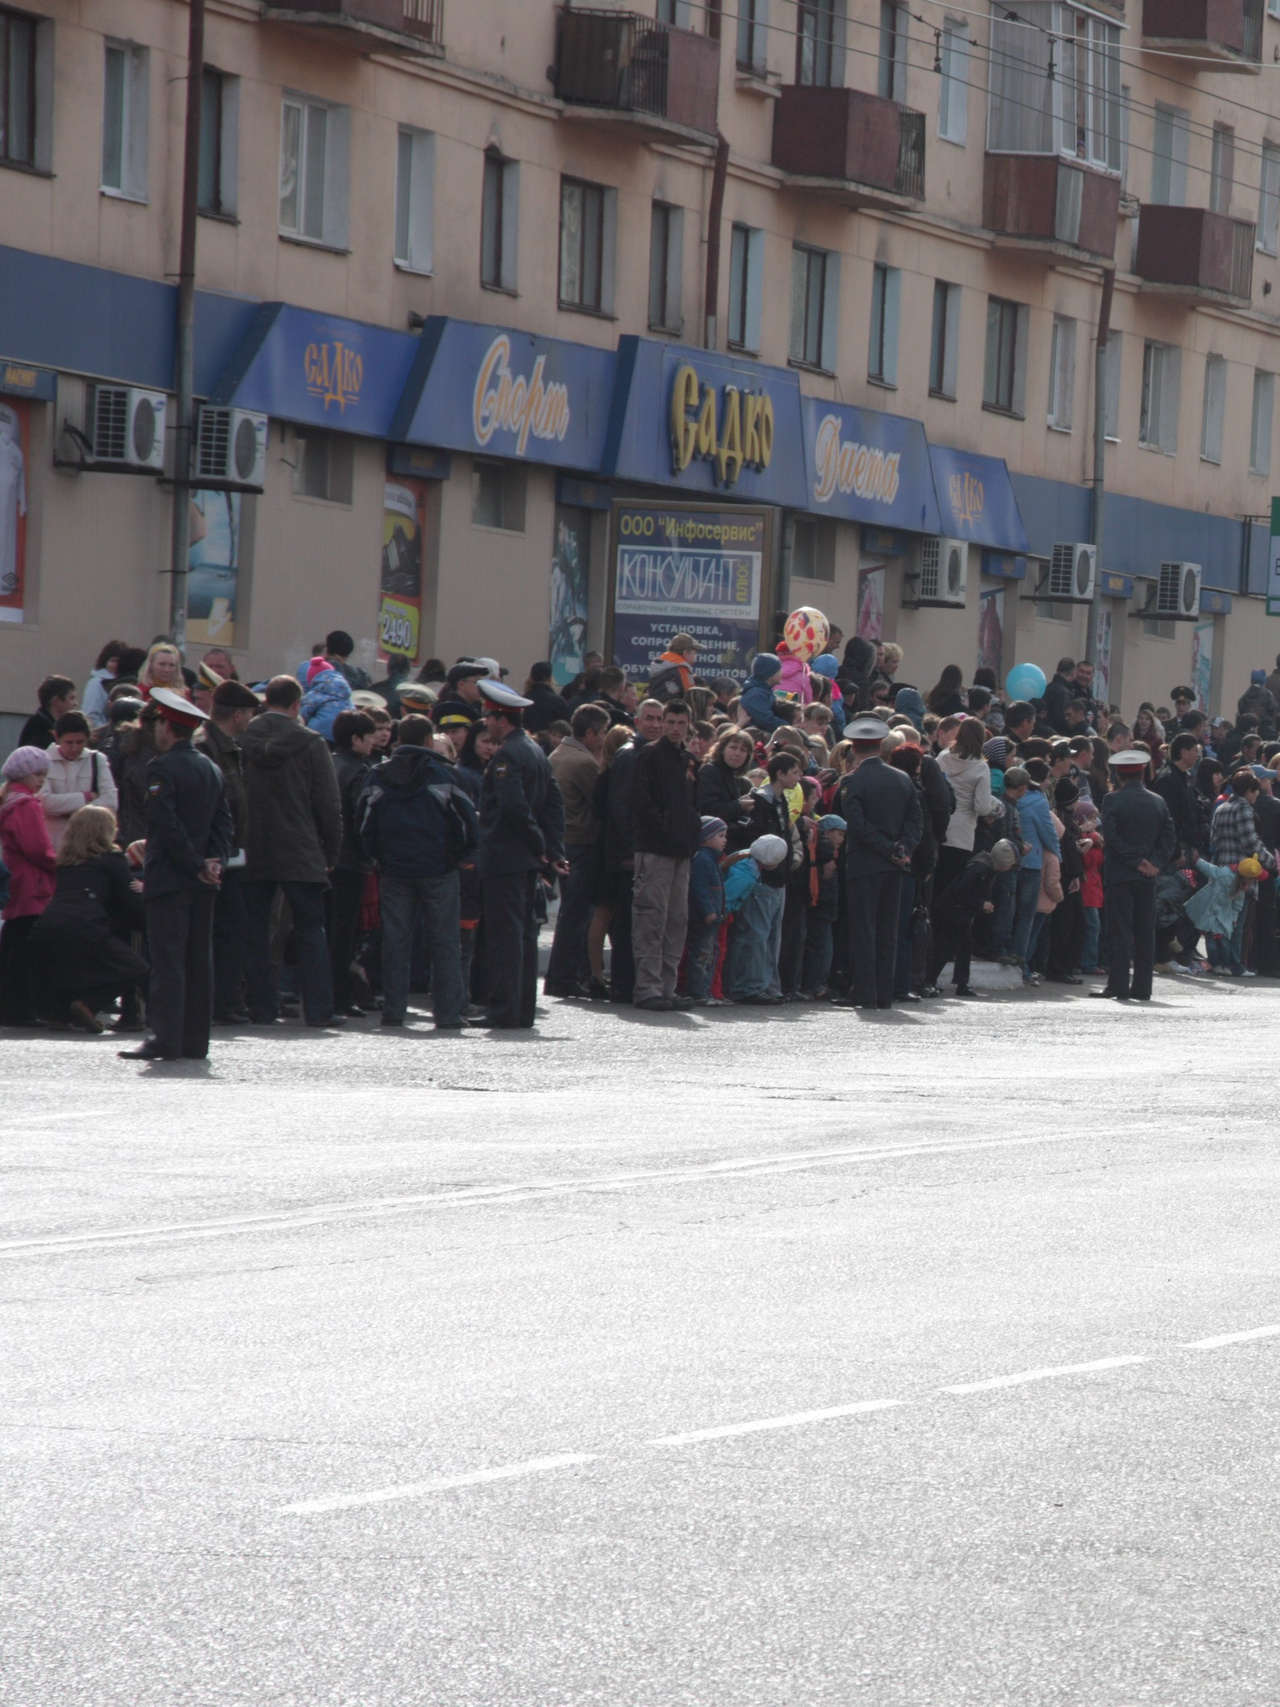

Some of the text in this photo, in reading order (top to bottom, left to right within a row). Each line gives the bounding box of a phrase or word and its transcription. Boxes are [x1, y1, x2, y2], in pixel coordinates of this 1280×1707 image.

[472, 333, 570, 457] Спорт
[620, 515, 655, 537] ООО
[622, 553, 739, 602] КОНСУЛЬТАНТ
[735, 558, 750, 603] ПЛЮС
[616, 602, 752, 617] СПРАВОЧНЫЕ ПРАВОВЫЕ СИСТЕМЫ
[384, 612, 412, 650] 2490
[650, 623, 724, 637] УСТАНОВКА,
[631, 636, 741, 652] СОПРОДЕНИЕ,
[648, 652, 723, 664] БЕТНОЕ
[693, 667, 748, 679] ЛИЕНТОВ
